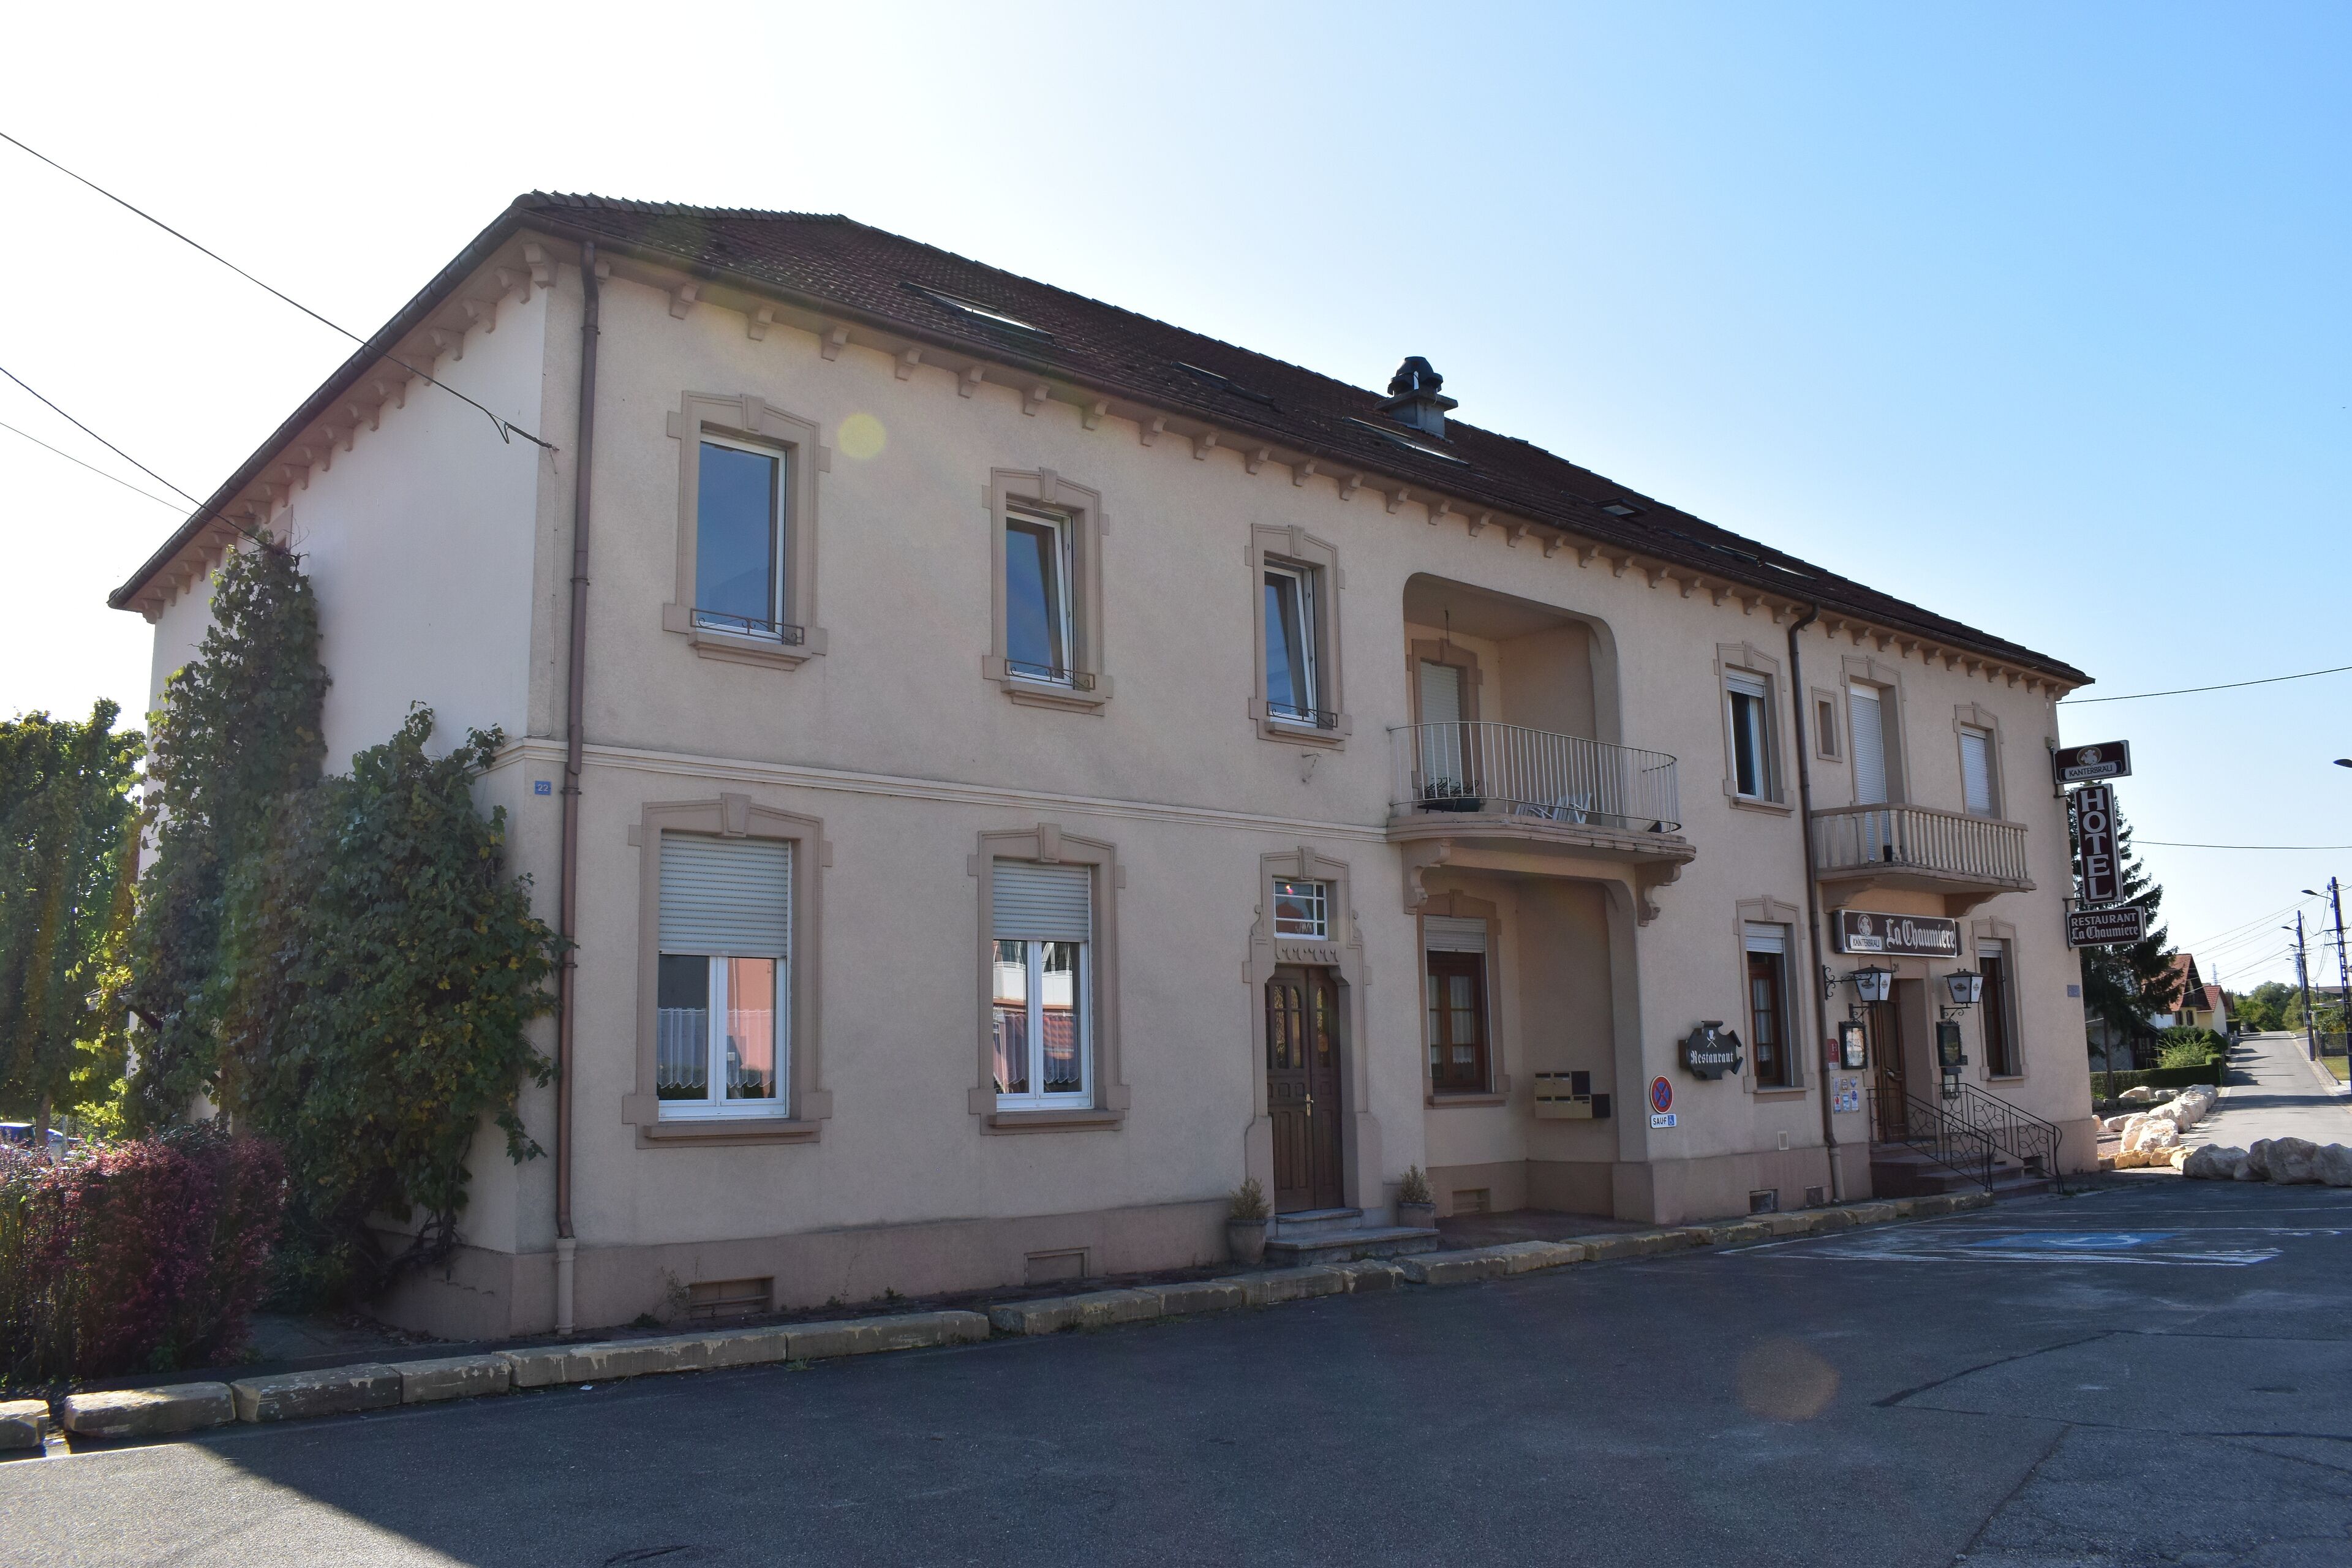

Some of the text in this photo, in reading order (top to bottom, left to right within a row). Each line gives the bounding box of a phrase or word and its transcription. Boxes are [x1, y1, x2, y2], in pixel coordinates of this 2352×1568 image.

[2080, 788, 2113, 900] HOTEL
[2071, 913, 2136, 927] RESTAURANT
[1886, 918, 1902, 948] La
[2071, 927, 2085, 941] La
[1831, 1043, 1838, 1052] H
[1691, 1050, 1733, 1064] Restaurant
[1653, 1117, 1667, 1125] SAUF
